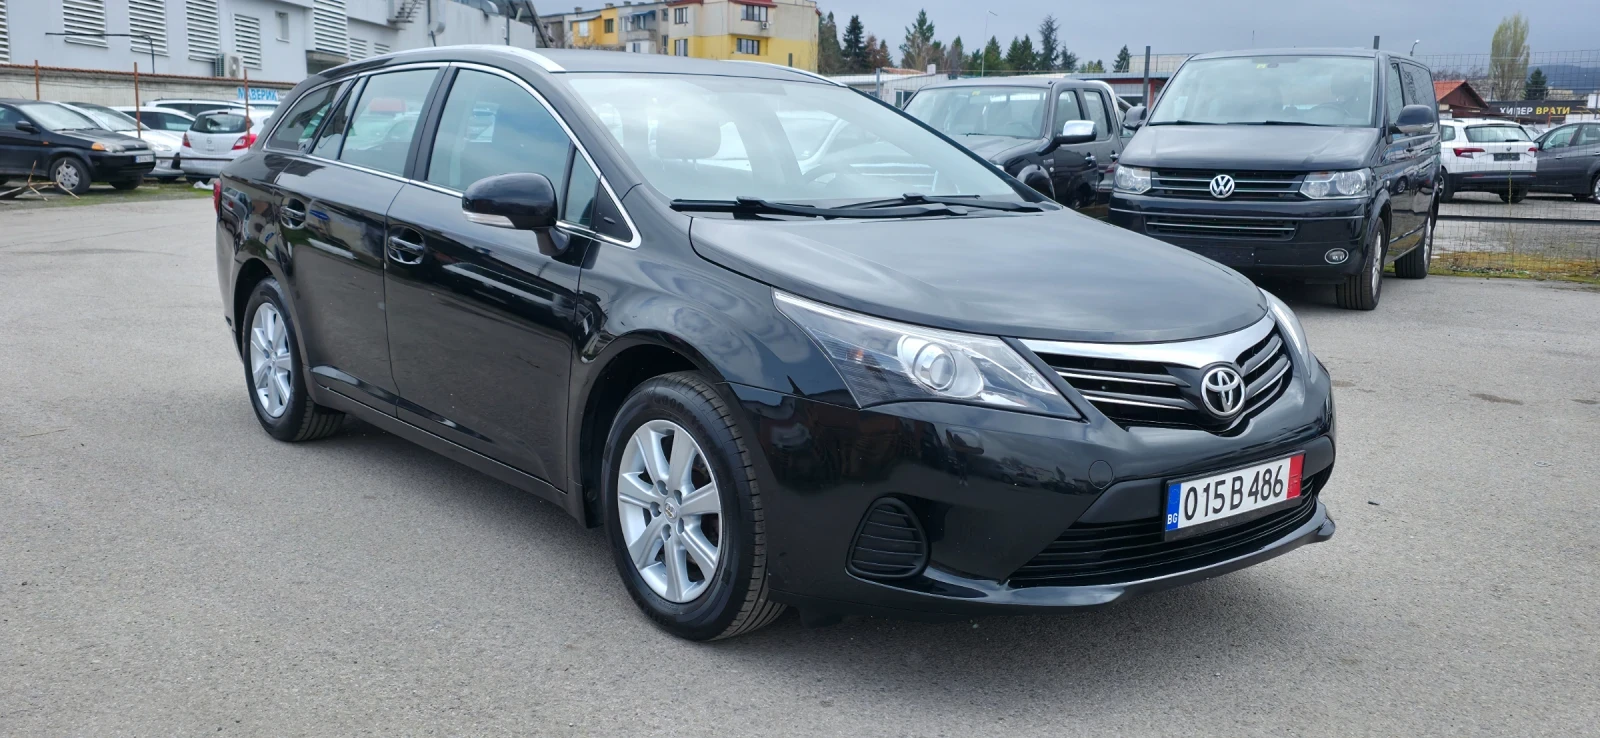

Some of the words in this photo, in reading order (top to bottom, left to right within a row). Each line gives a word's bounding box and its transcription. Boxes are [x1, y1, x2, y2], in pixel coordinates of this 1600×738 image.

[237, 87, 278, 101] МВЕРИК
[1500, 106, 1533, 115] ХИПЕР
[1535, 106, 1570, 115] ВРАТИ
[1167, 512, 1178, 525] BG
